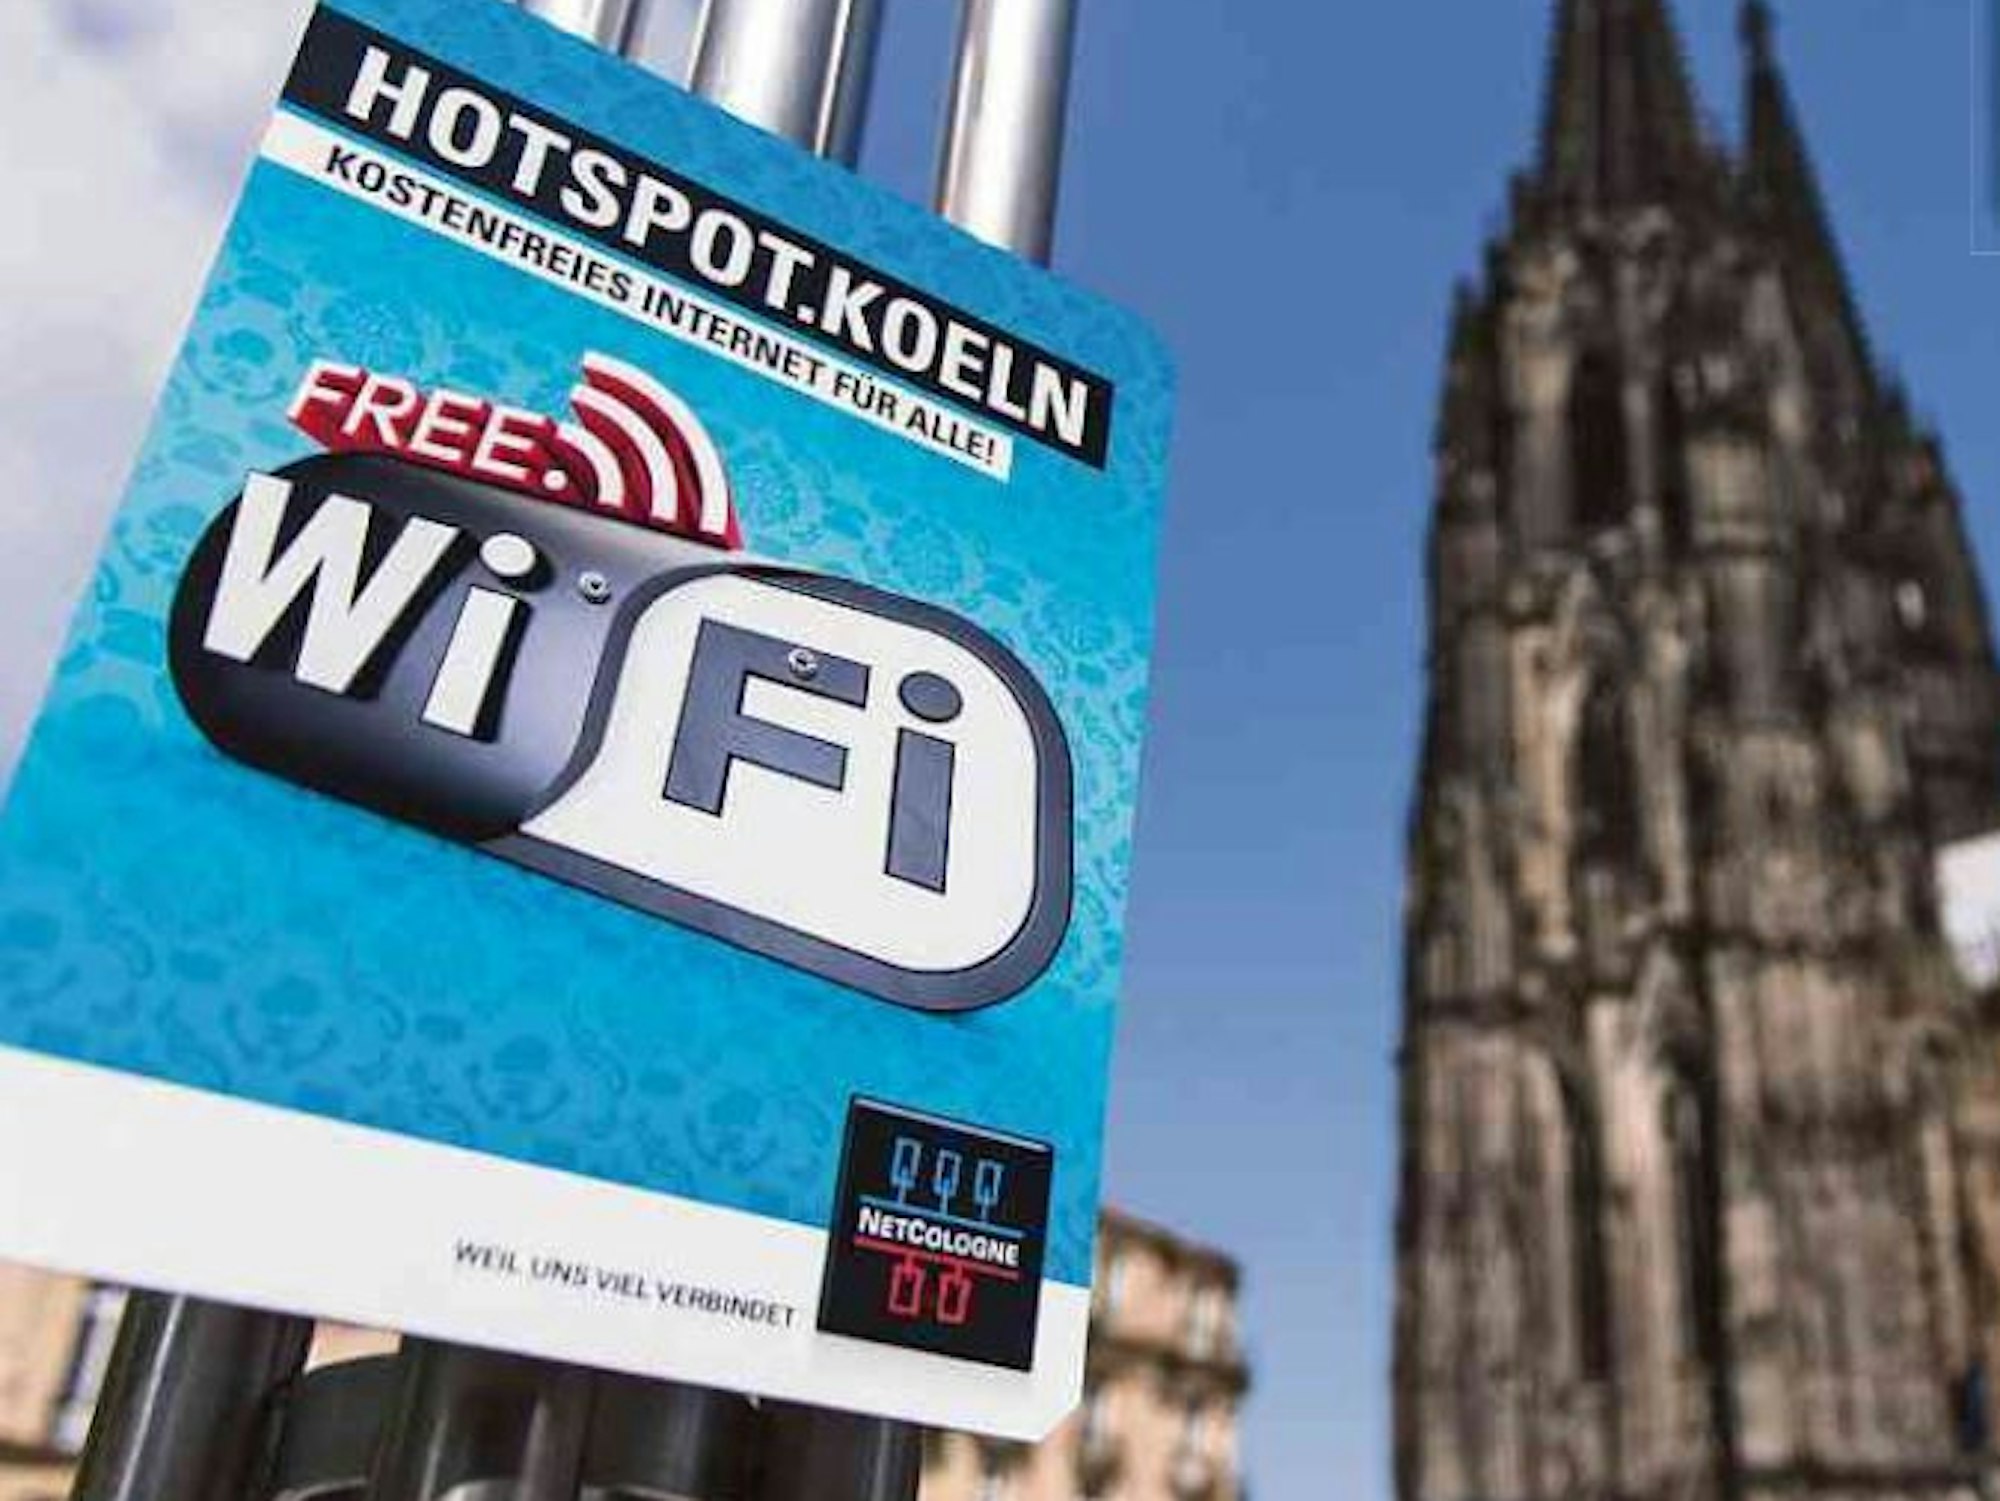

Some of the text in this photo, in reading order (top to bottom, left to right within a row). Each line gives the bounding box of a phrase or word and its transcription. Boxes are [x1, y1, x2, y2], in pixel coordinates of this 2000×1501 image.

[325, 145, 997, 467] KOSTENFREIES INTERNET FÜR ALLE!
[346, 45, 1091, 447] HOTSPOT.KOELN
[455, 1238, 796, 1330] WEIL UNS VIEL VERBINDET
